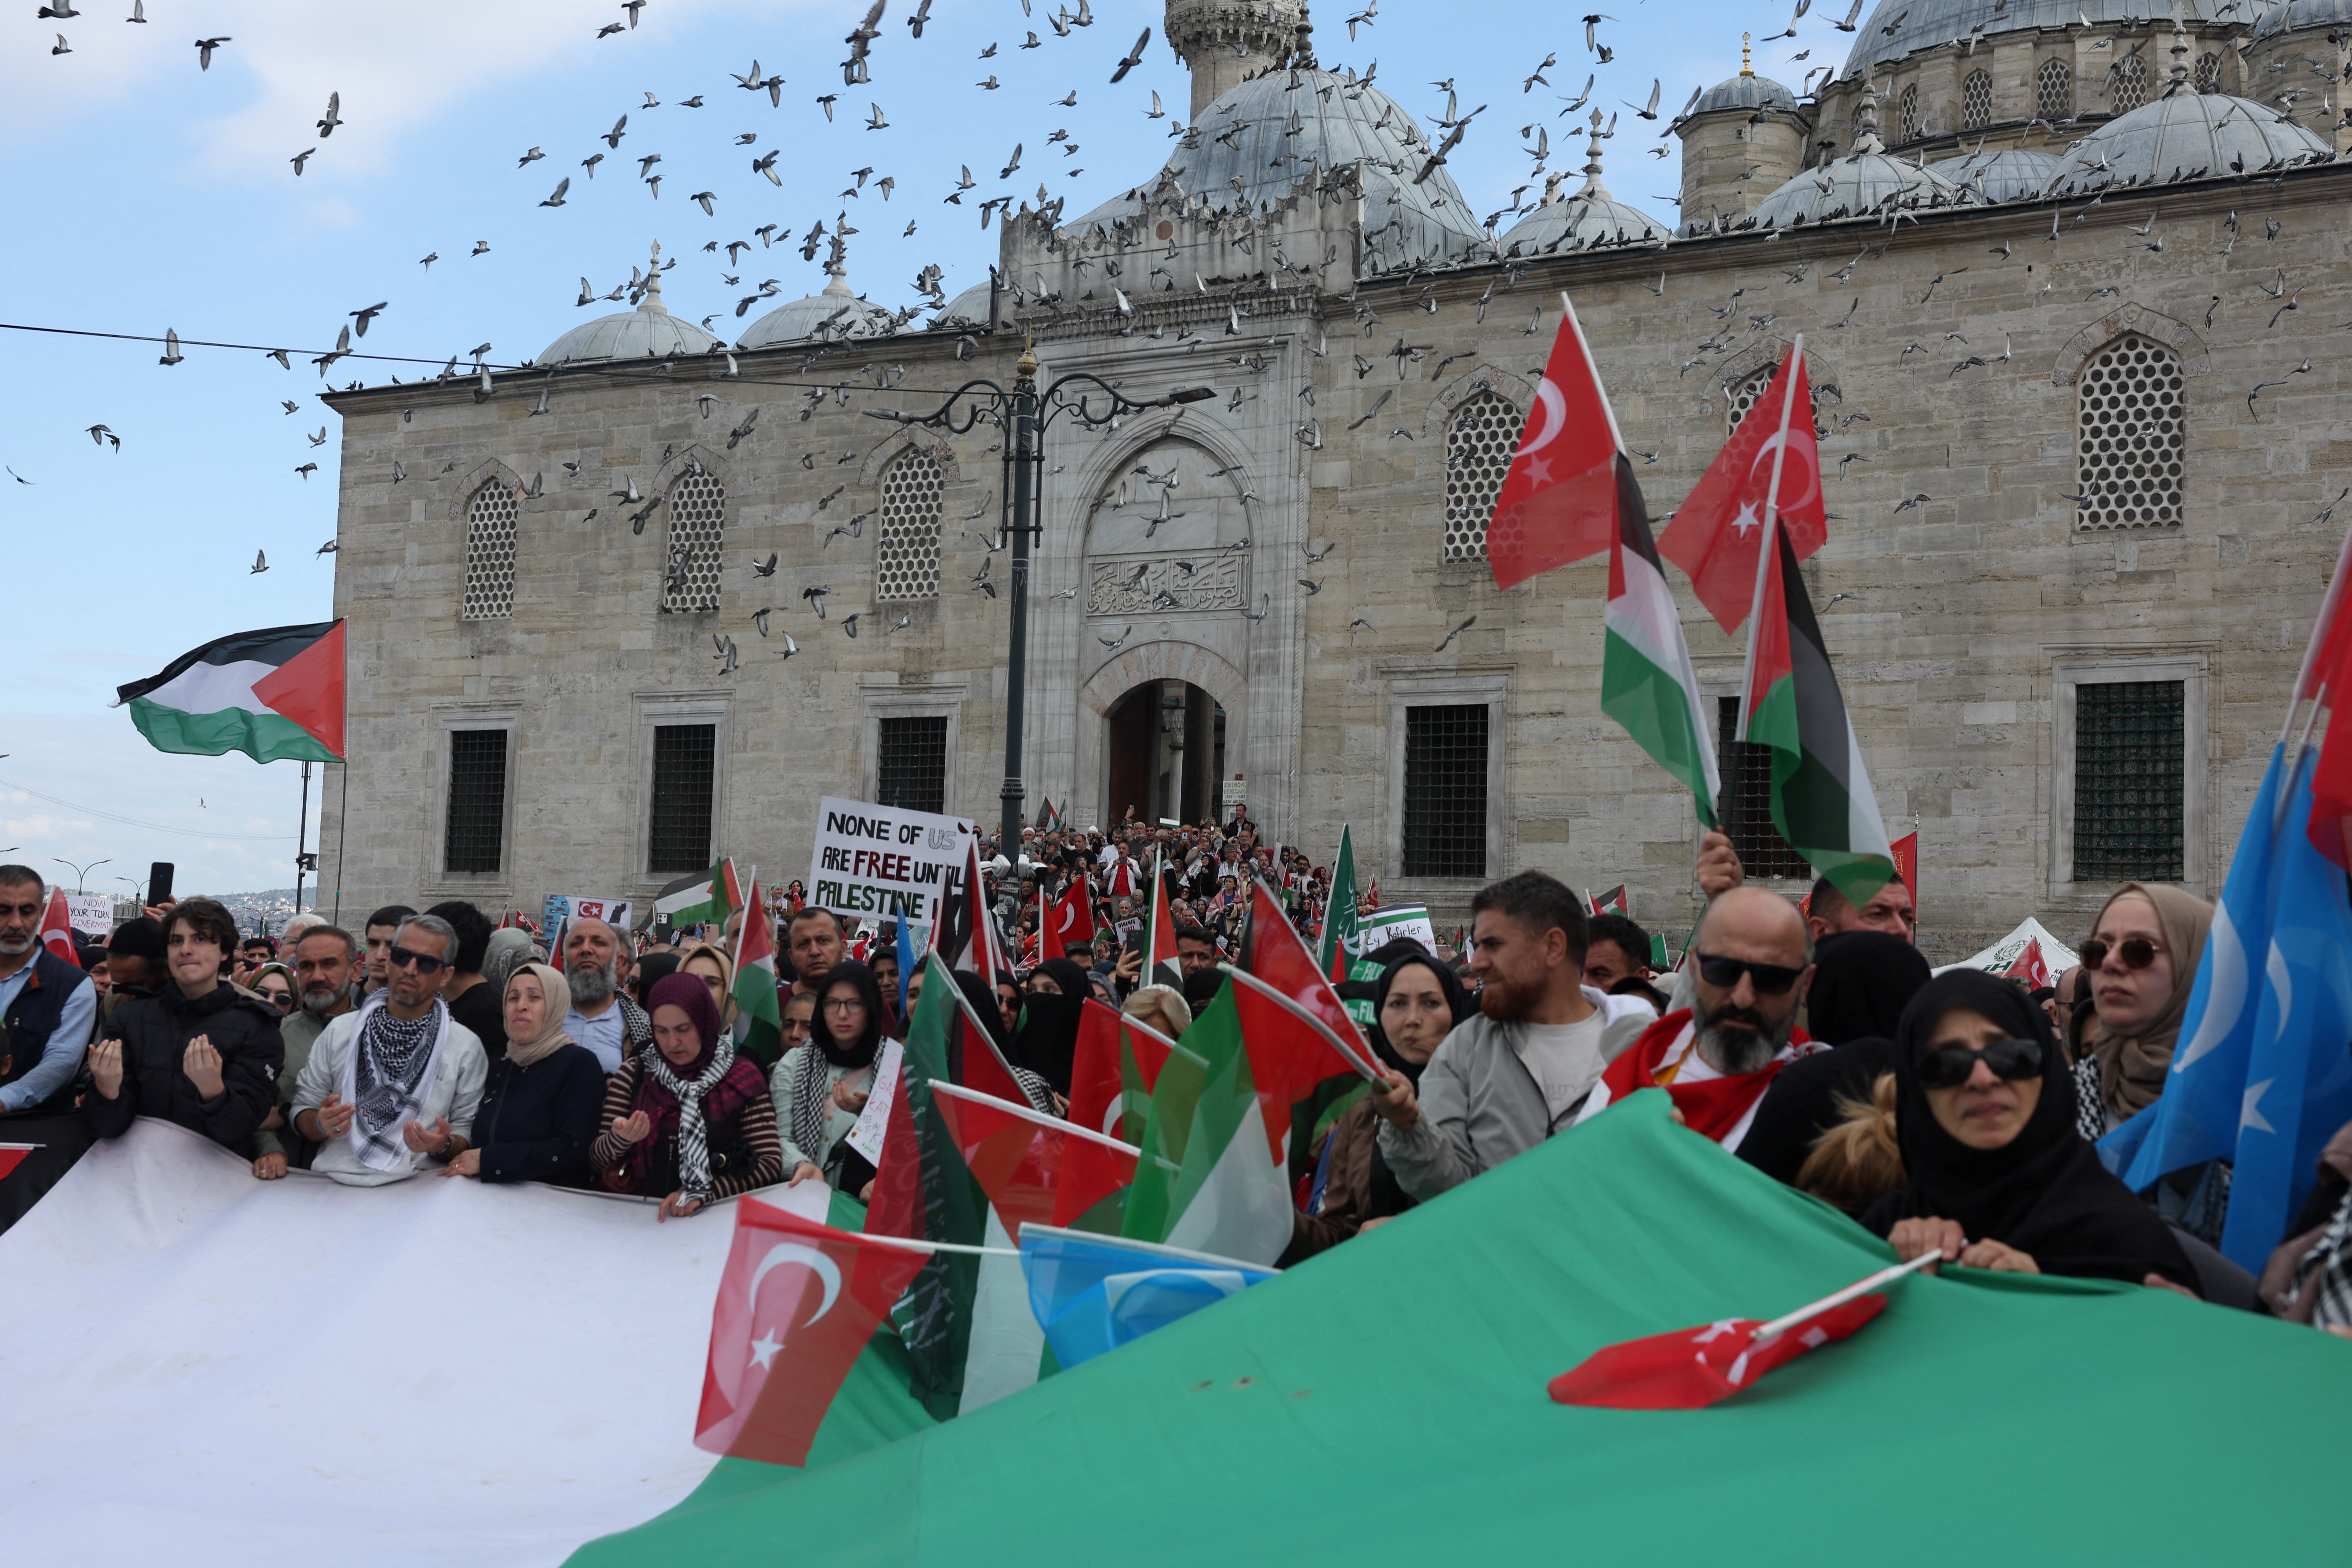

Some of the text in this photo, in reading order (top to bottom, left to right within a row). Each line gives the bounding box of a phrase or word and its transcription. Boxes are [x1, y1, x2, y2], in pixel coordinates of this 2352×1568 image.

[826, 811, 956, 850] NONE OF US
[821, 846, 851, 871] ARE
[853, 850, 911, 882] FREE
[83, 899, 105, 908] NOW
[815, 880, 924, 919] PALESTINE
[70, 907, 109, 919] YOUR TURN
[73, 918, 112, 929] GOVERMENTS
[1365, 924, 1422, 949] Ey Kafirler
